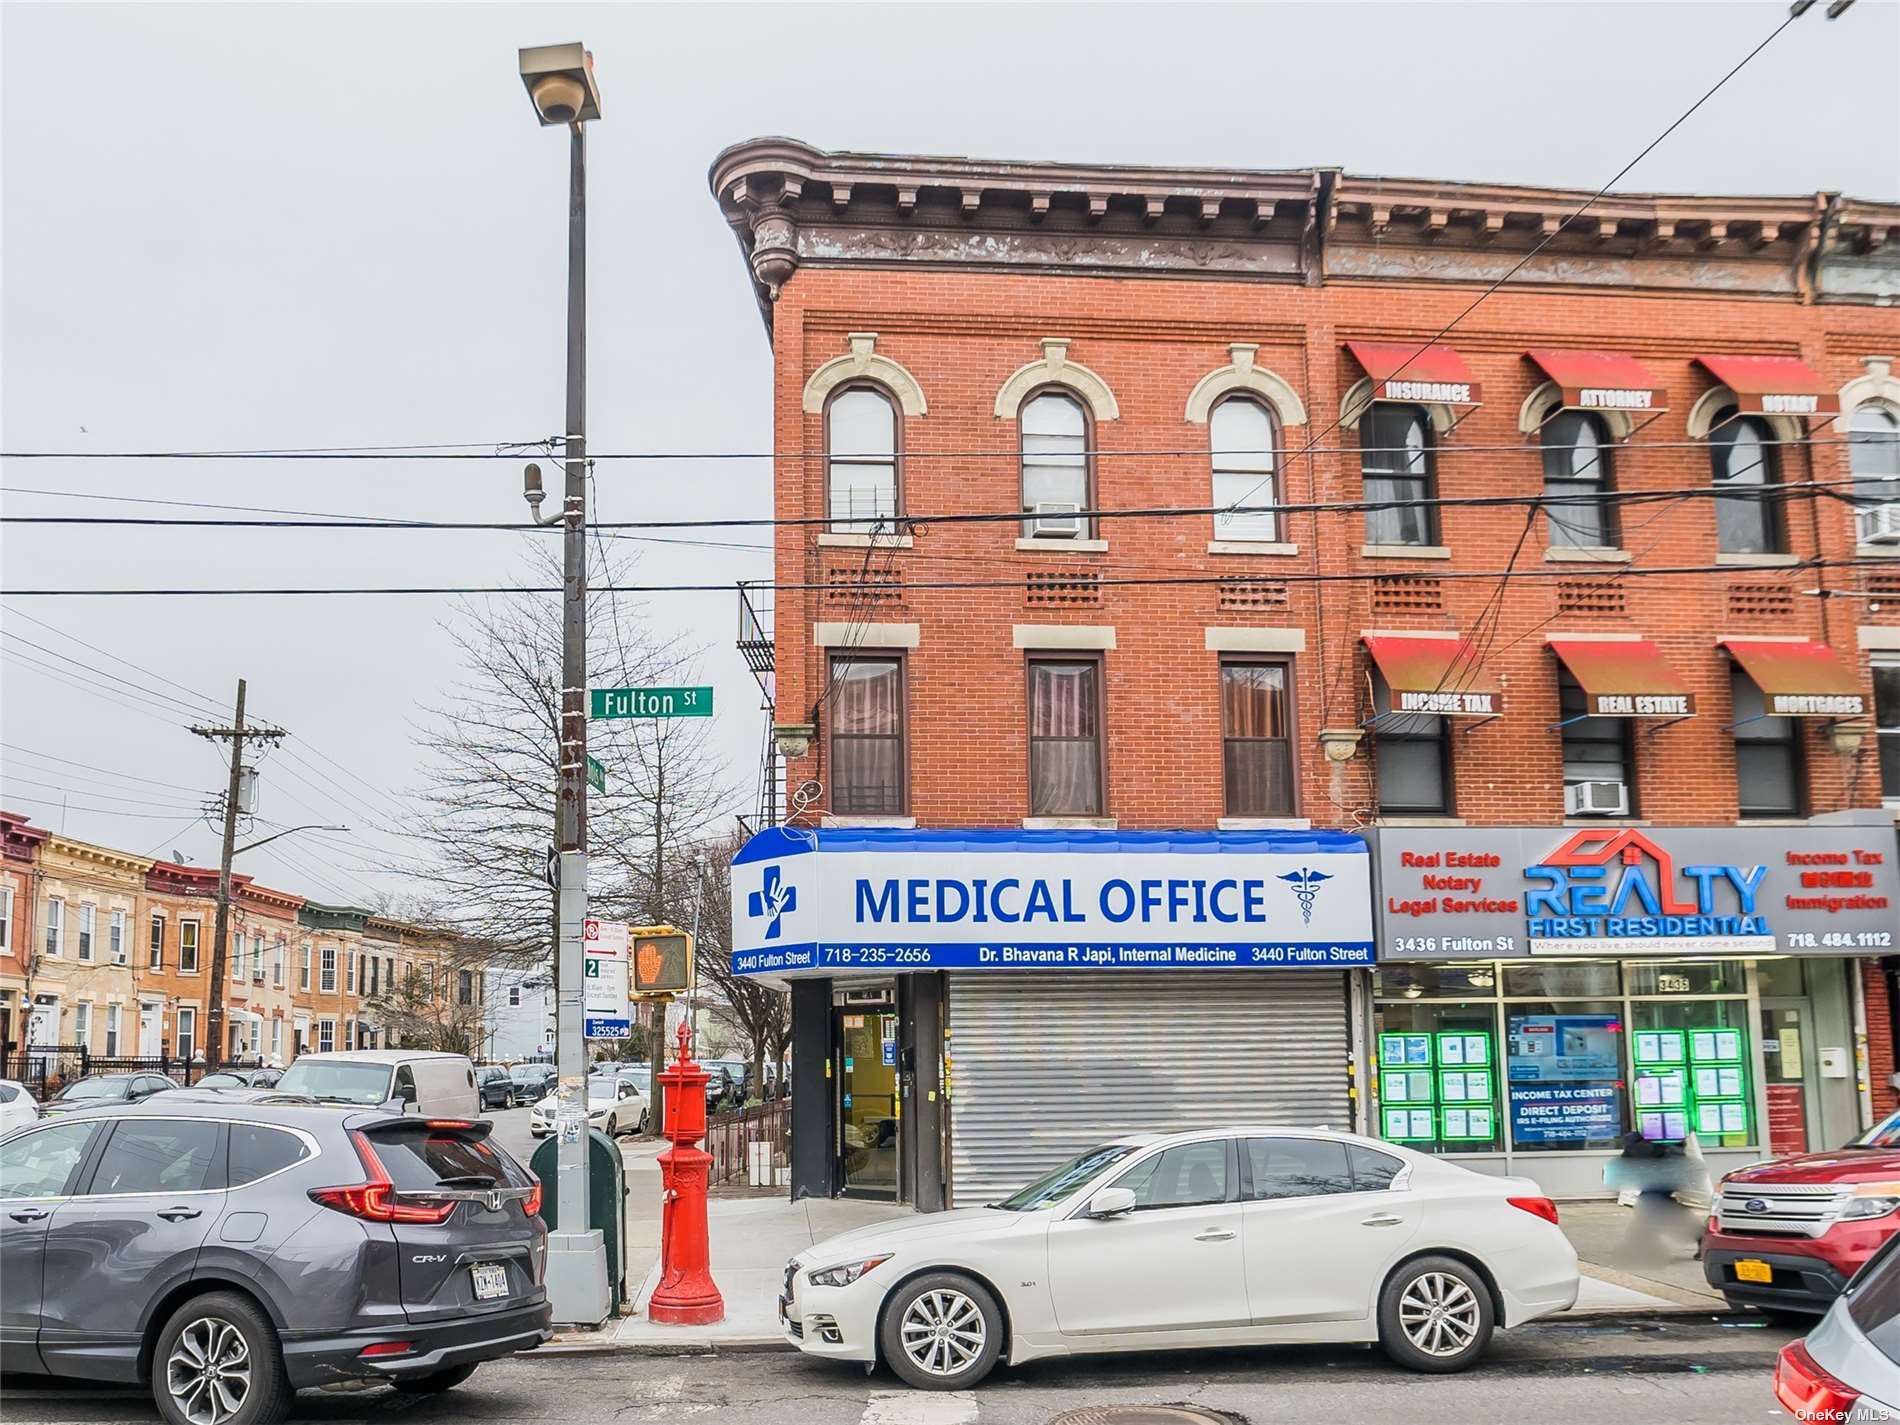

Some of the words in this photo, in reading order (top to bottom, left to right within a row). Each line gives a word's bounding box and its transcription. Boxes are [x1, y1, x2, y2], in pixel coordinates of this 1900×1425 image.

[1385, 381, 1471, 402] INSURANCE
[605, 691, 674, 715] Fulton
[683, 691, 697, 706] St
[1401, 692, 1462, 712] INCOME
[1463, 694, 1493, 713] TAX
[1598, 696, 1634, 713] REAL
[1635, 696, 1687, 714] ESTATE
[1773, 695, 1864, 714] MORTGAGES
[1401, 852, 1440, 868] Real
[1446, 852, 1501, 868] Estate
[1785, 850, 1848, 866] Income
[1852, 848, 1884, 865] Tax
[1423, 875, 1482, 894] Notary
[1524, 851, 1769, 916] REALTY
[855, 879, 1086, 923] MEDICAL
[1099, 878, 1267, 924] OFFICE
[1388, 897, 1438, 917] Legal
[1442, 897, 1519, 914] Services
[1785, 894, 1888, 913] Immigration
[1528, 917, 1601, 938] FIRST
[1605, 915, 1775, 937] RESIDENTIAL
[1252, 947, 1284, 961] 3440
[1287, 946, 1327, 961] Fulton
[1330, 947, 1368, 960] Street
[1395, 938, 1436, 952] 3436
[1442, 937, 1493, 951] Fulton
[1496, 937, 1515, 951] St
[737, 956, 757, 970] 3440
[758, 953, 784, 968] Fulton
[785, 950, 811, 965] Street
[825, 948, 931, 963] 718-235-2656
[979, 947, 999, 962] Dr.
[1003, 947, 1064, 962] Bhavana
[1067, 948, 1079, 962] R
[1082, 947, 1116, 965] Japi,
[1119, 947, 1171, 961] Internal
[1175, 947, 1237, 962] Medicine
[588, 961, 597, 977] 2
[592, 1026, 619, 1037] 325525
[1511, 1090, 1552, 1100] INCOME
[1553, 1089, 1573, 1099] TAX
[1573, 1088, 1613, 1098] CENTER
[1520, 1106, 1560, 1116] DIRECT
[1562, 1104, 1607, 1115] DEPOSIT
[412, 1255, 447, 1263] CR-V
